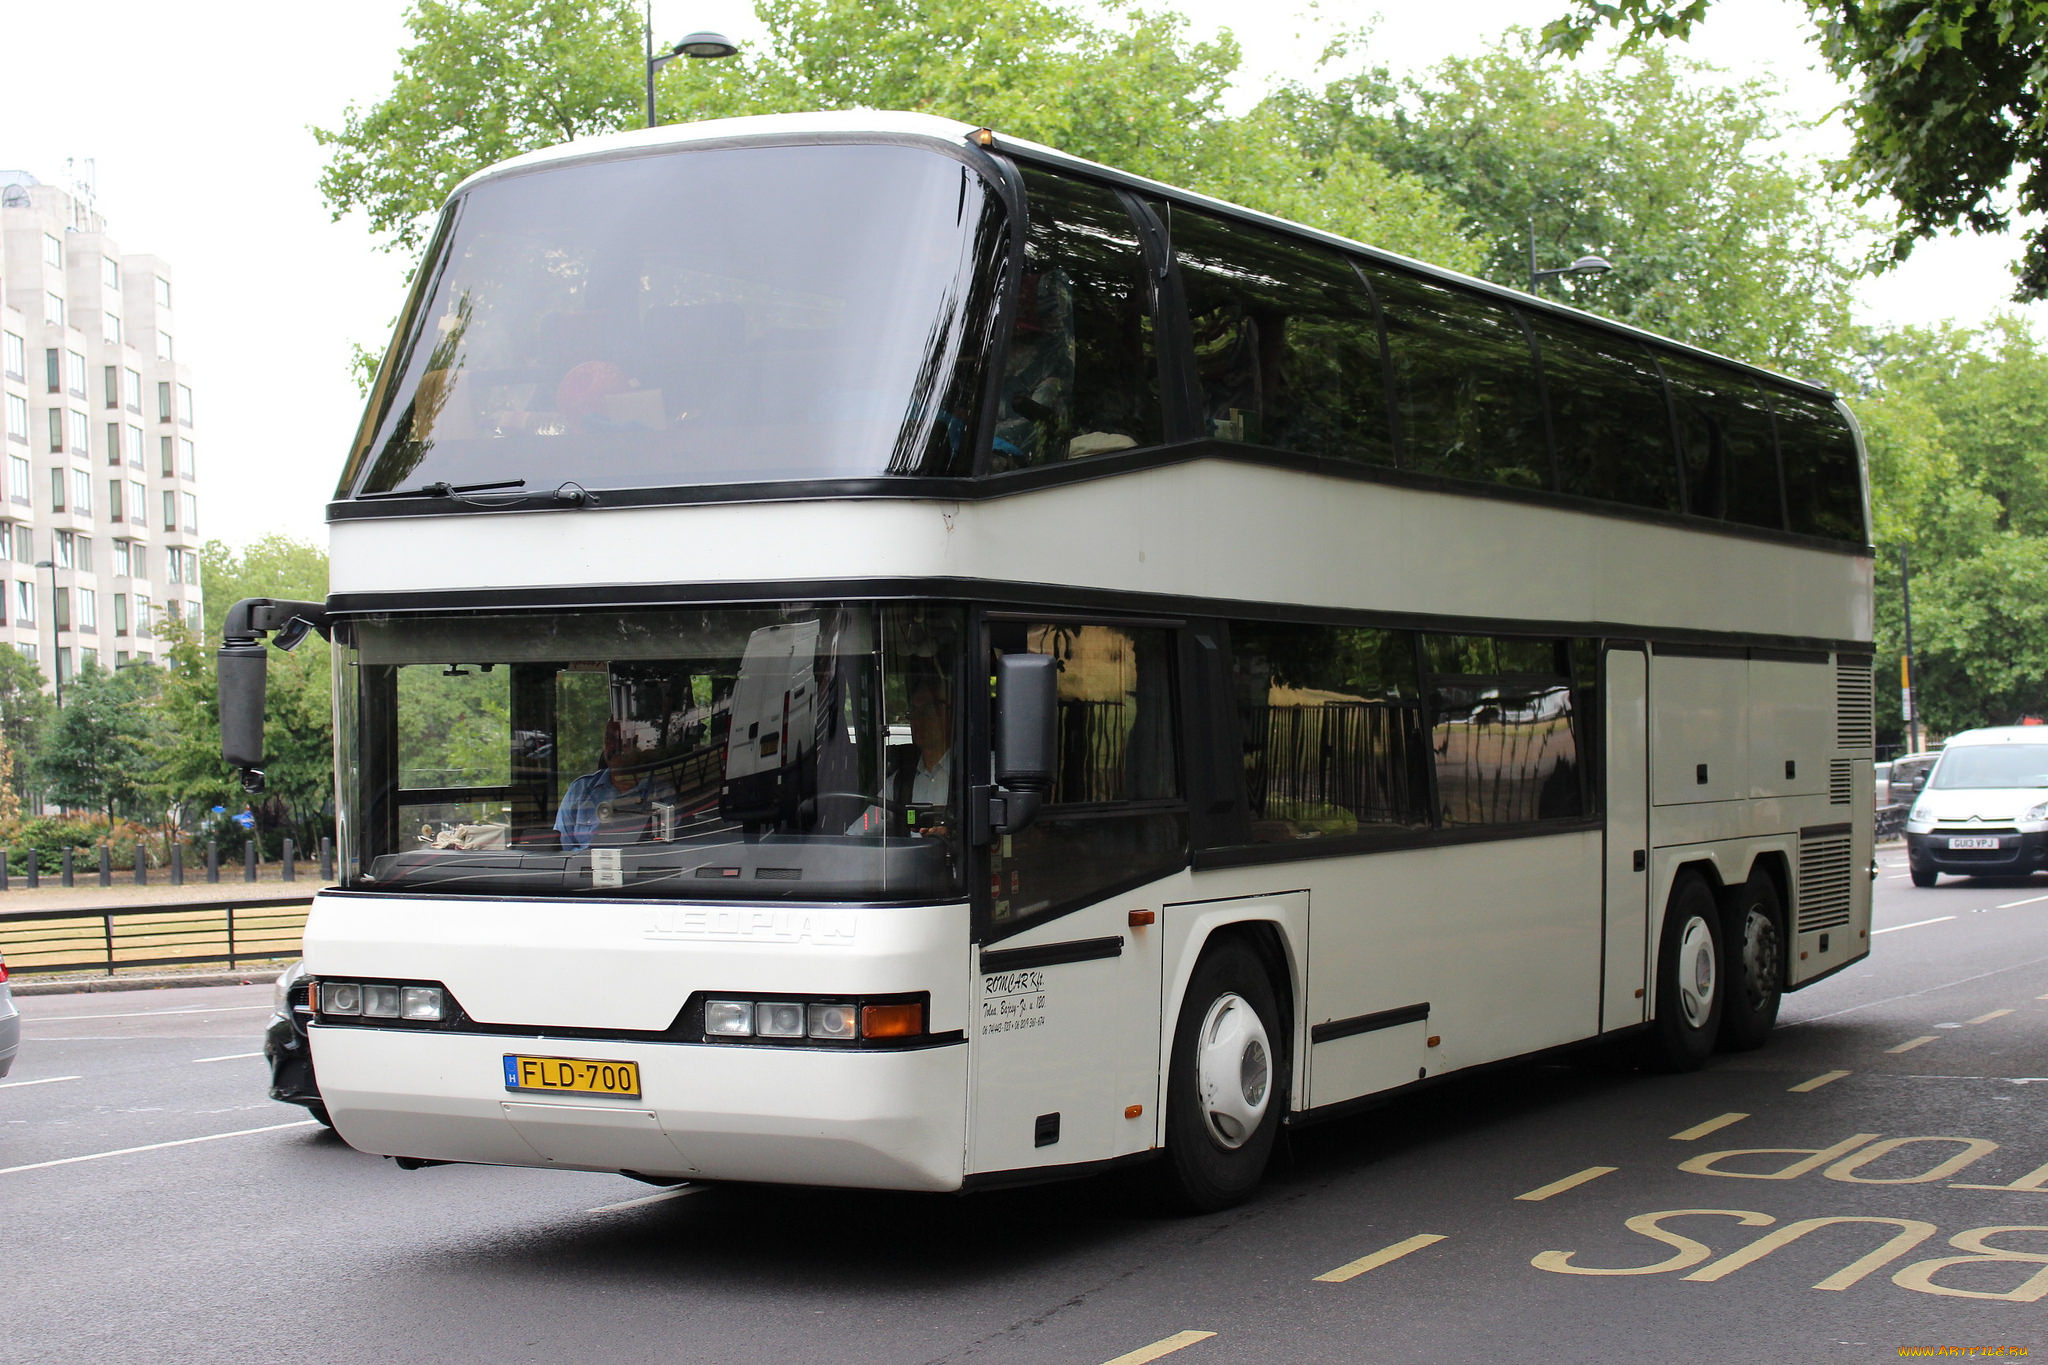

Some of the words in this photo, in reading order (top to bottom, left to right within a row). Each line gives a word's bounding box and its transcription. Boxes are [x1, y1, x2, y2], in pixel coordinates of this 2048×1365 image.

[1954, 839, 1974, 848] GU13
[1976, 839, 1994, 848] VPJ
[643, 910, 859, 940] NEOPLAN
[985, 972, 1029, 994] ROMCAR
[508, 1073, 516, 1083] H
[522, 1060, 631, 1091] FLD-700
[1530, 1209, 2048, 1302] BUS
